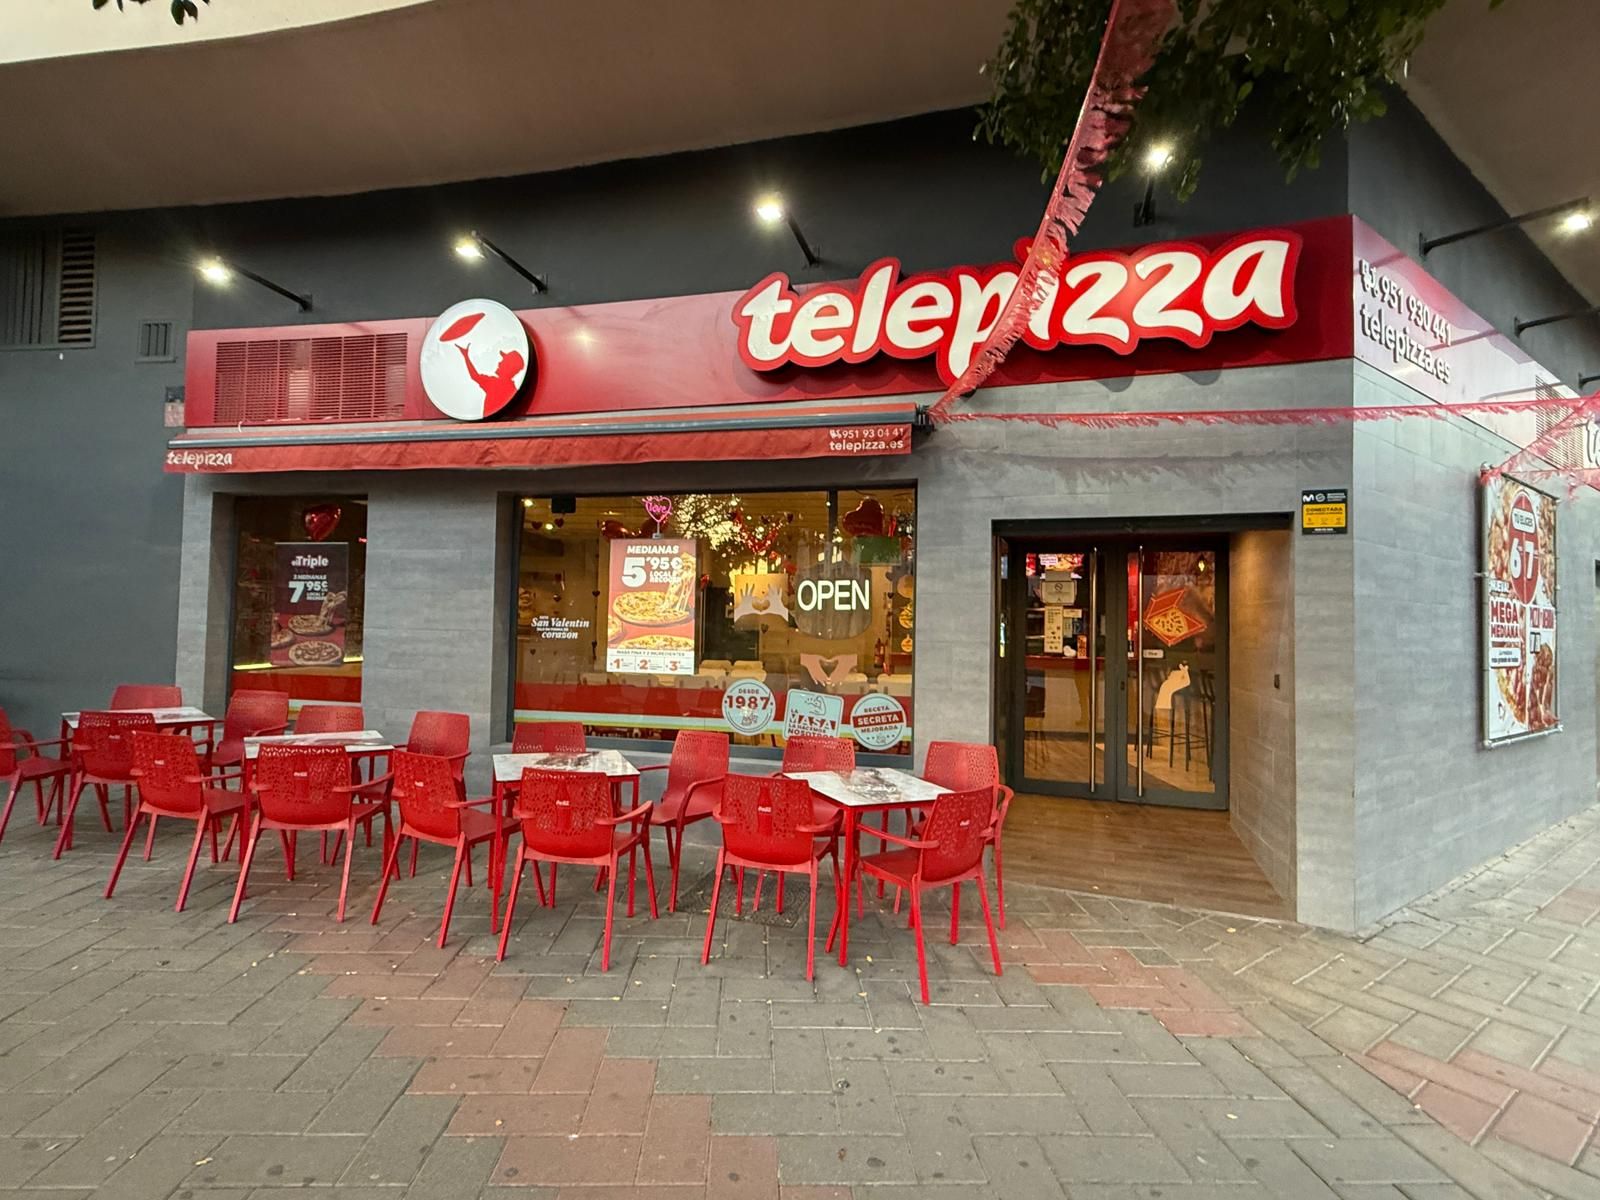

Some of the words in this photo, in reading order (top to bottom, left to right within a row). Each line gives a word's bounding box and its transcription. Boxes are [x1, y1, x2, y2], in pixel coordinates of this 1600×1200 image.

[741, 239, 1291, 379] telepizza
[1379, 275, 1404, 314] 951
[1406, 294, 1431, 332] 930
[1431, 313, 1452, 347] 441
[1360, 303, 1451, 384] telepizza.es
[841, 429, 859, 439] 951
[862, 428, 876, 438] 93
[829, 438, 904, 453] telepizza.es
[167, 450, 233, 470] telepizza
[626, 546, 679, 555] MEDIANAS
[797, 579, 870, 611] OPEN
[1490, 600, 1519, 624] MEGA
[530, 617, 549, 627] San
[726, 695, 770, 710] 1987
[857, 713, 900, 726] SECRETA
